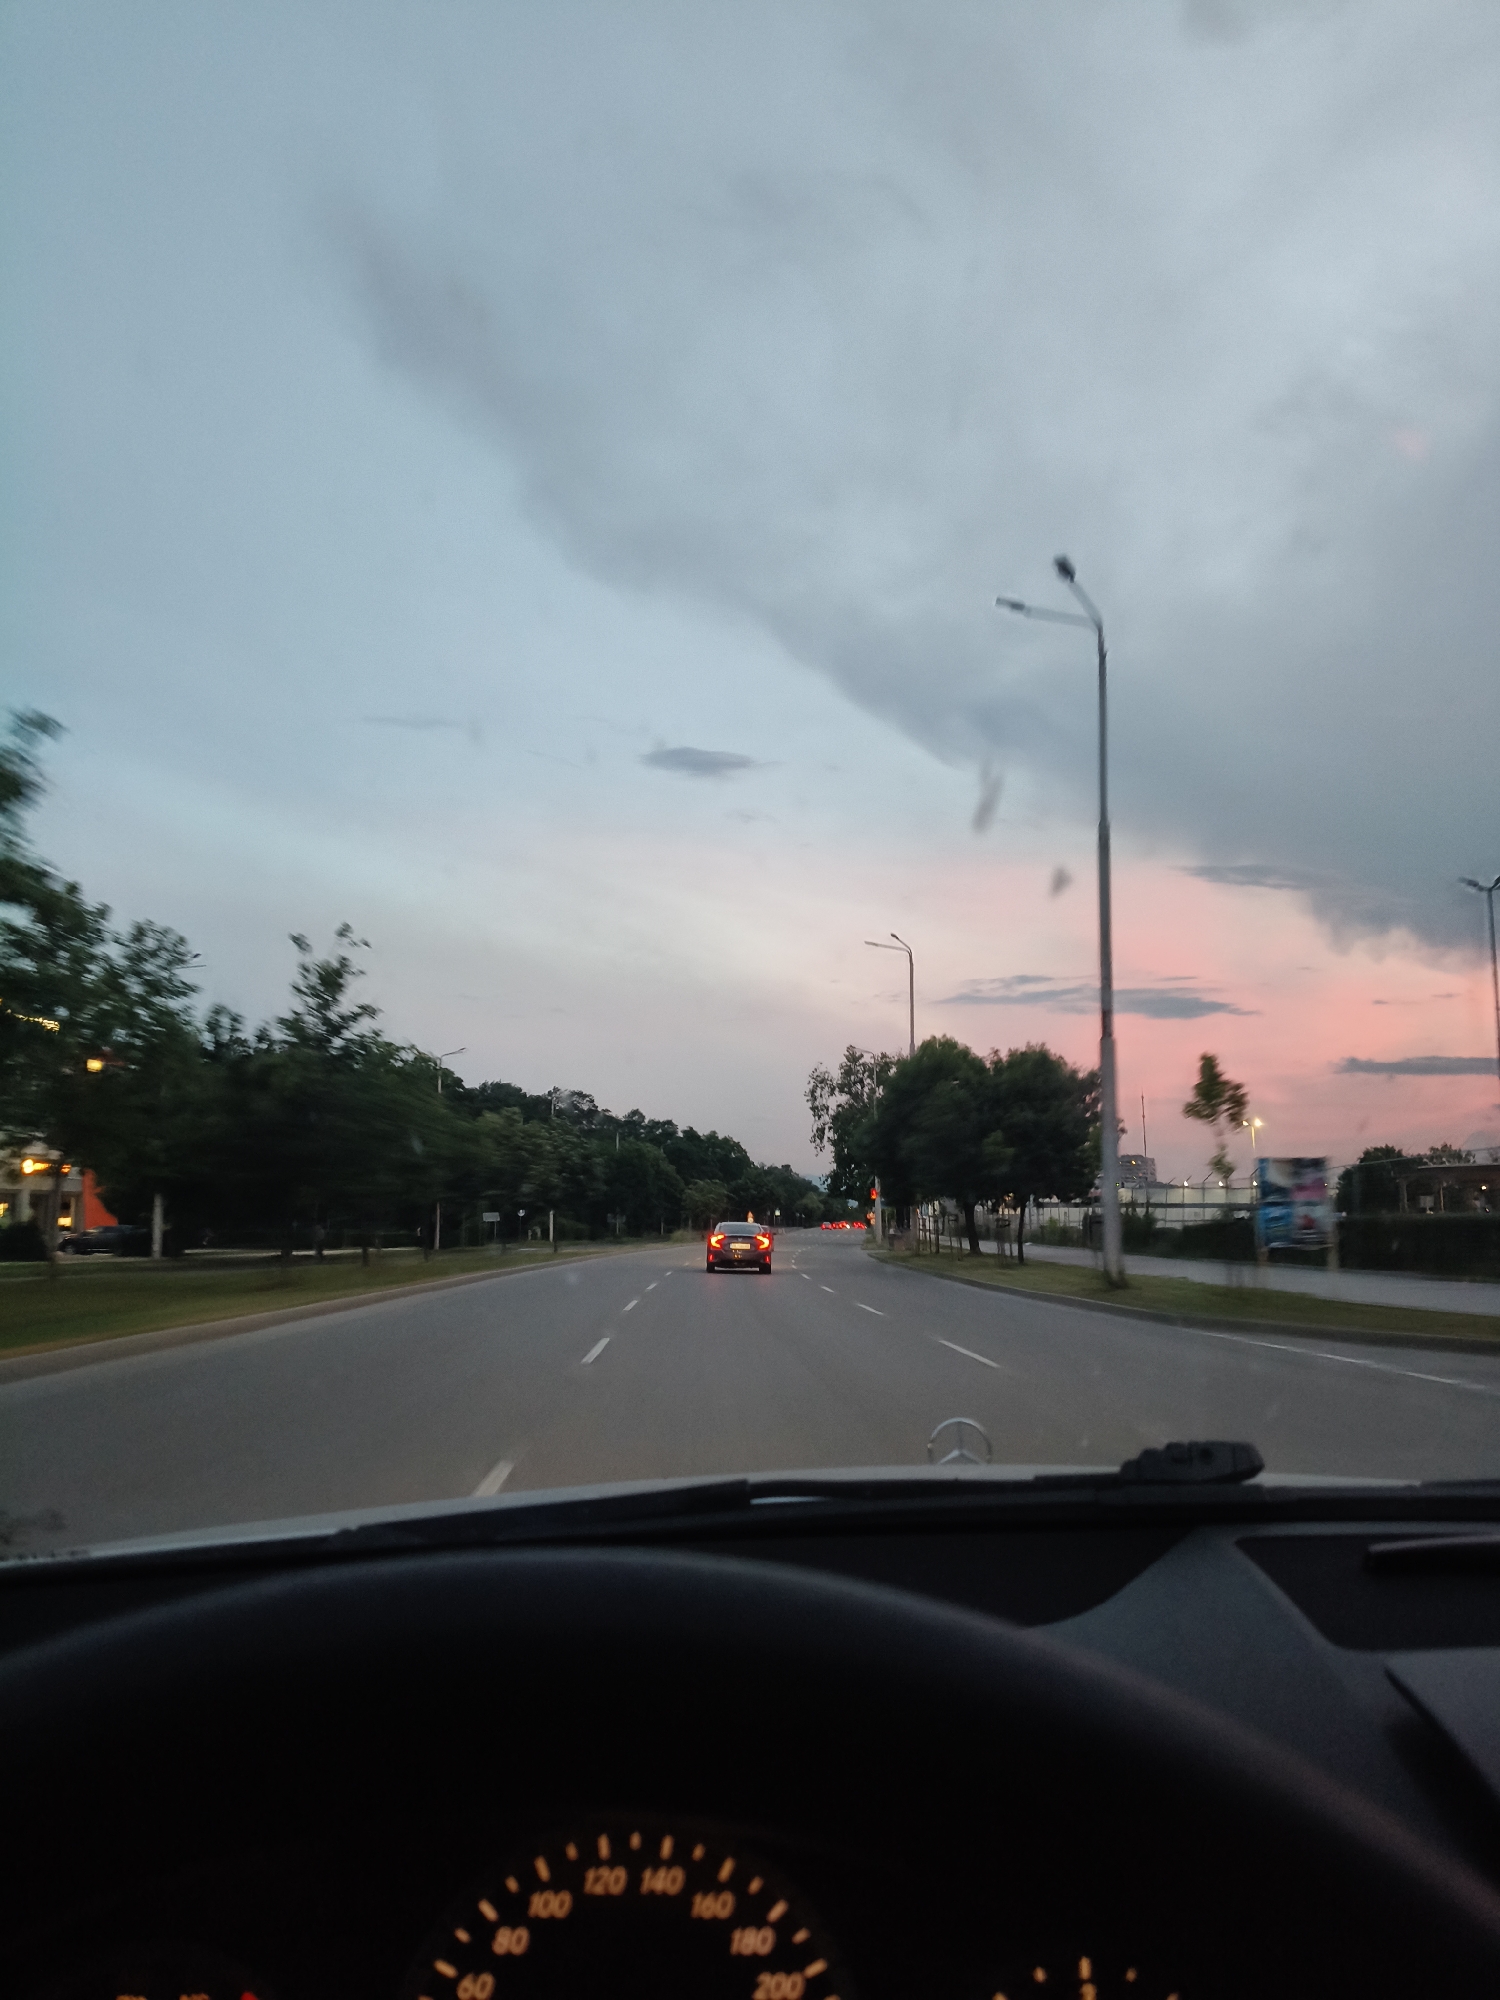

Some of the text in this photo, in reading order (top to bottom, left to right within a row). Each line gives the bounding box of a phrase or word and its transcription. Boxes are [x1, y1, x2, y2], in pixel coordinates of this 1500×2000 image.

[584, 1865, 628, 1895] 120
[640, 1865, 686, 1896] 140
[528, 1890, 573, 1919] 100
[691, 1890, 735, 1919] 160
[492, 1926, 530, 1955] 80
[730, 1926, 776, 1956] 180
[456, 1972, 495, 2000] 60
[752, 1972, 806, 2000] 200
